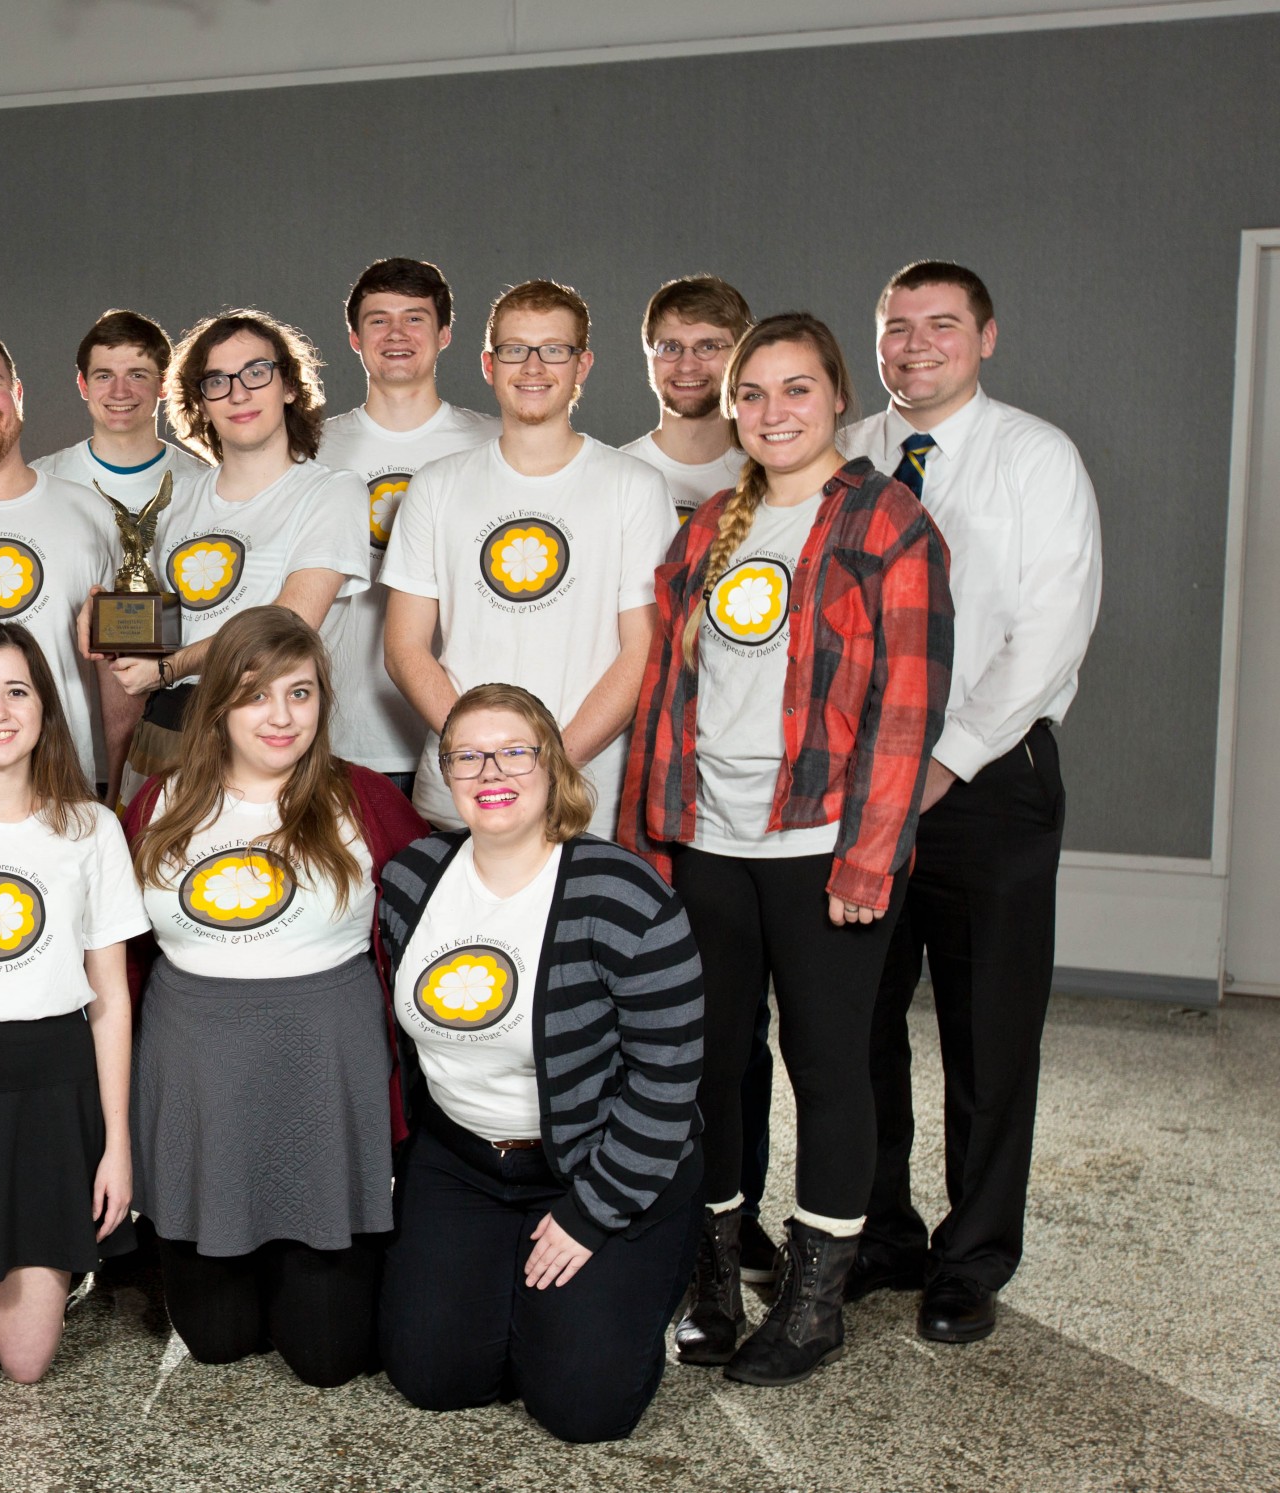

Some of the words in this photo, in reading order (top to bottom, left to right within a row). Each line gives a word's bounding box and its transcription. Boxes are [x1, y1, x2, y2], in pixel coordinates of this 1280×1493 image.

[368, 467, 385, 478] Karl
[193, 529, 209, 537] Karl
[212, 527, 244, 539] Forensics
[498, 512, 516, 523] Karl
[519, 509, 555, 521] Forensics
[556, 517, 574, 541] Forum
[28, 538, 46, 560] Forum
[32, 595, 50, 614] Team
[203, 606, 229, 620] Debate
[229, 585, 247, 605] Team
[475, 580, 490, 598] PLU
[489, 596, 515, 613] Speech
[529, 596, 558, 613] Debate
[556, 577, 576, 595] Team
[703, 624, 719, 641] PLU
[722, 640, 745, 657] Speech
[757, 642, 781, 658] Debate
[779, 631, 790, 641] Te
[211, 841, 232, 853] Karl
[29, 872, 49, 896] Forum
[172, 912, 194, 930] PLU
[193, 926, 226, 943] Speech
[231, 936, 241, 944] &
[244, 926, 279, 943] Debate
[278, 906, 304, 928] Team
[5, 955, 35, 973] Debate
[34, 934, 53, 955] Team
[454, 936, 473, 947] Karl
[476, 935, 511, 951] Forensics
[510, 947, 526, 973] Forum
[404, 1001, 419, 1021] PLU
[418, 1020, 452, 1039] Speech
[468, 1031, 501, 1042] Debate
[499, 1013, 524, 1033] Team
